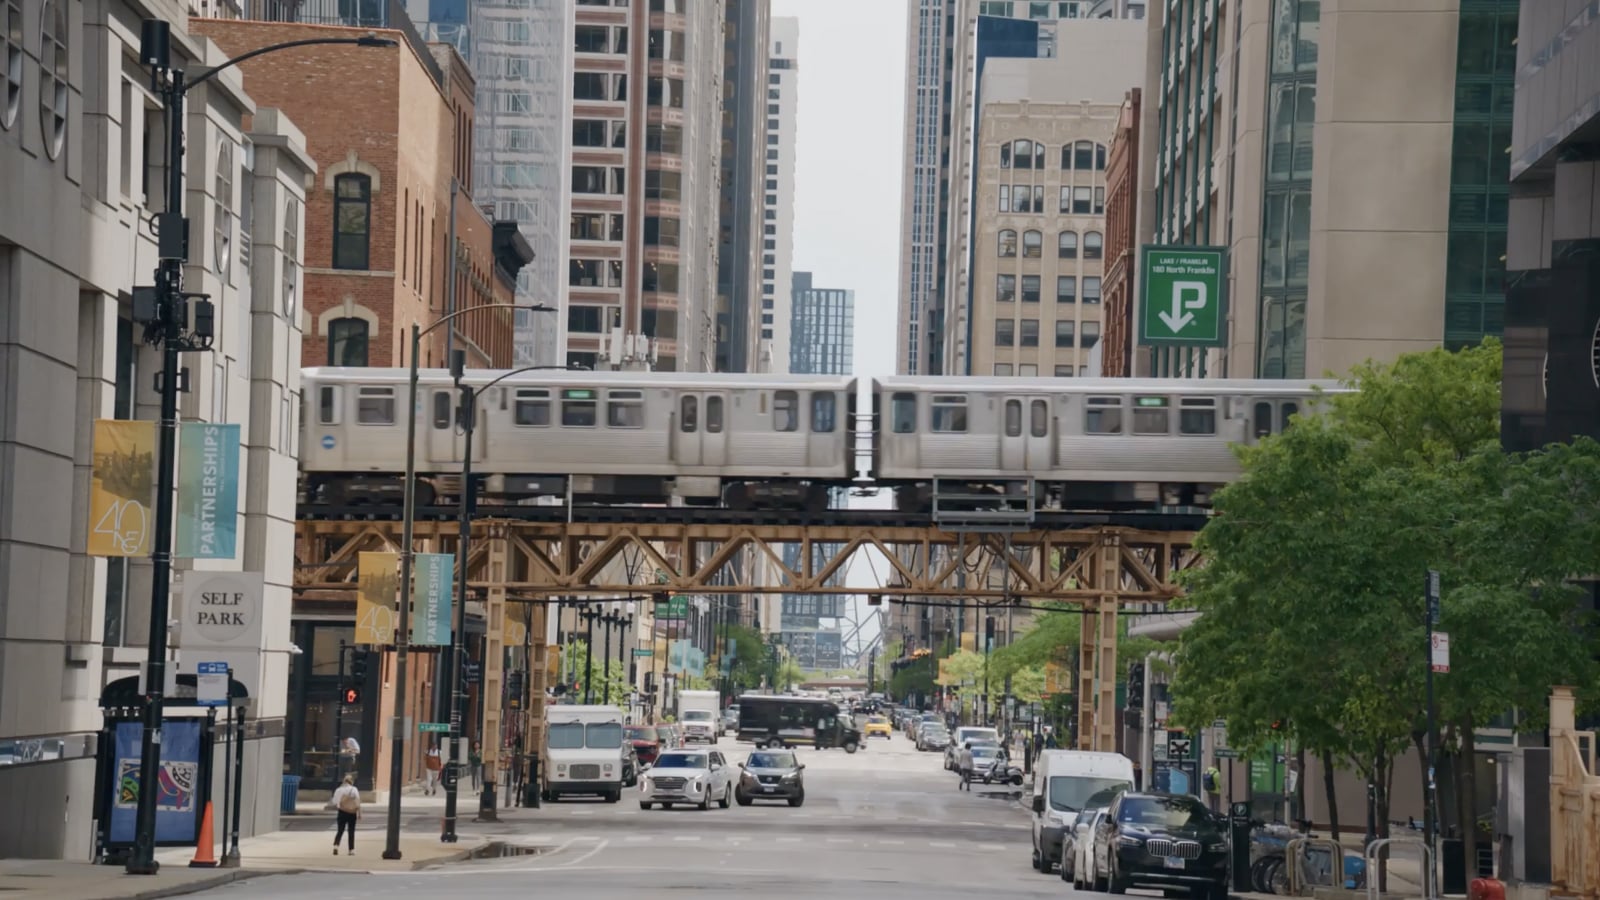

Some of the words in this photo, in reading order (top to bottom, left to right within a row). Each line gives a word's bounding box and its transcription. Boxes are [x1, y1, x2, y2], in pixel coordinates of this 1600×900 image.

[1166, 266, 1185, 274] North
[1187, 266, 1216, 274] Franklin
[200, 426, 219, 554] PARTNERSHIPS
[201, 592, 243, 606] SELF
[427, 556, 440, 642] PARTNERSHIPS
[197, 611, 245, 626] PARK
